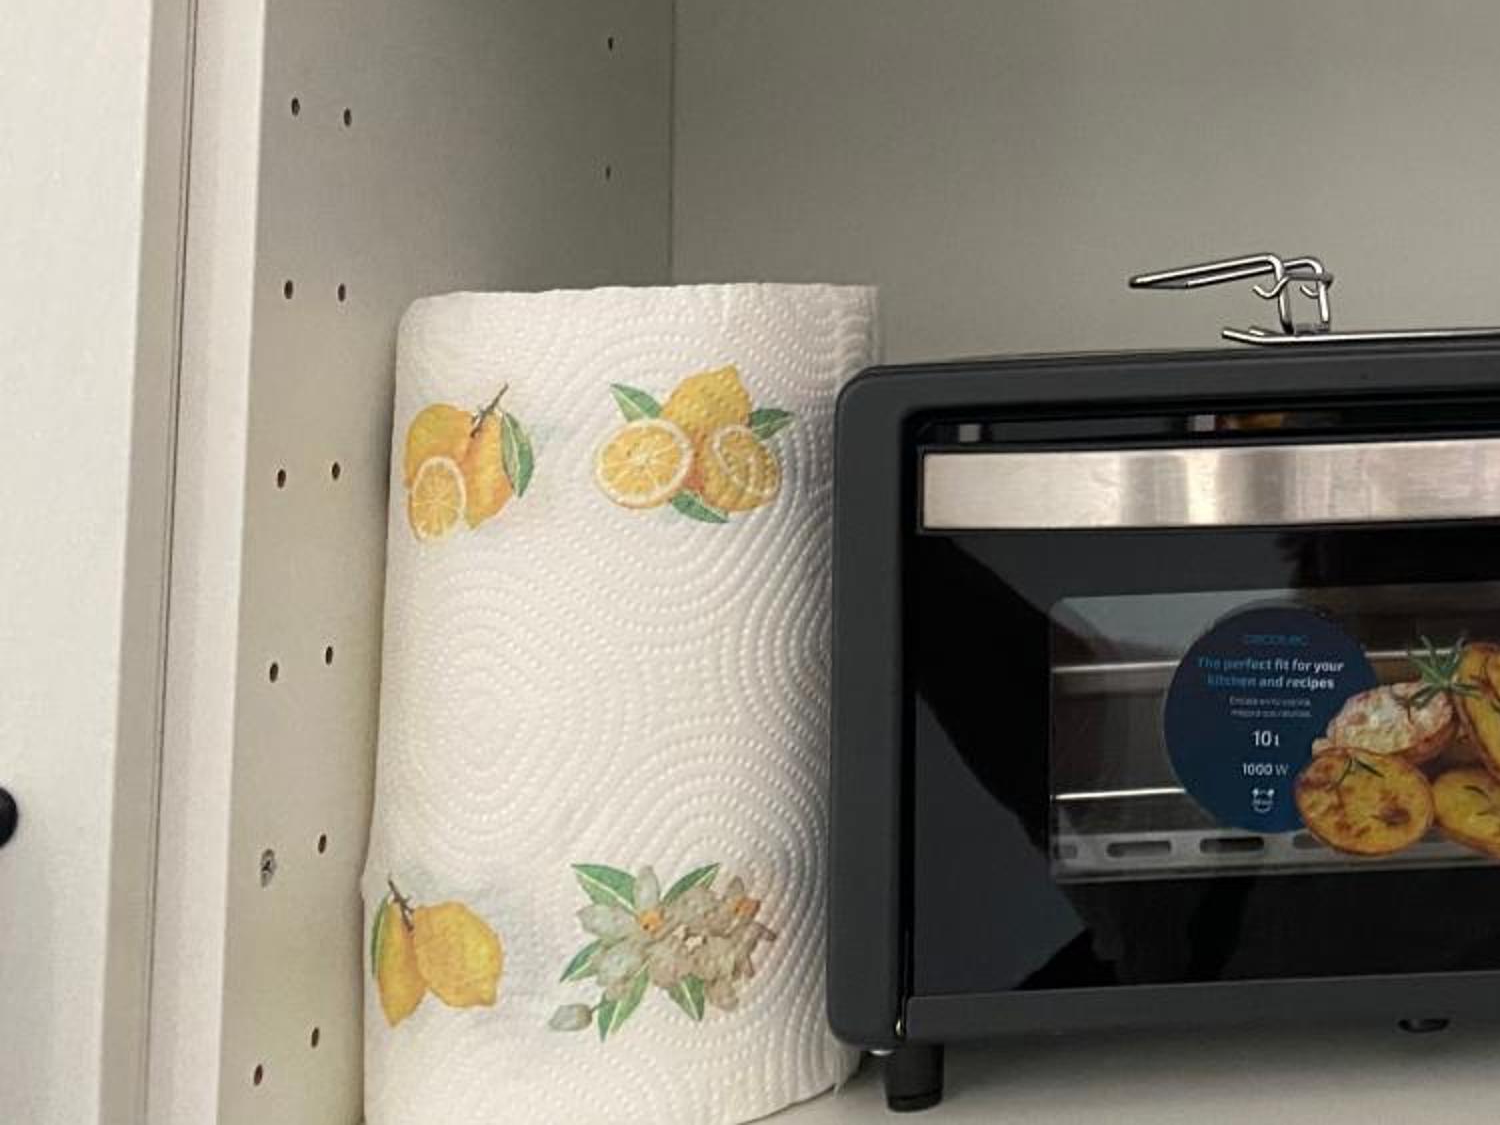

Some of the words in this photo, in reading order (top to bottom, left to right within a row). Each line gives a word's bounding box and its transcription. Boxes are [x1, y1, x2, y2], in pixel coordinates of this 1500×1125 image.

[1199, 657, 1220, 668] The
[1223, 657, 1272, 672] perfect
[1275, 657, 1289, 669] fit
[1292, 658, 1311, 671] for
[1313, 661, 1345, 673] your
[1207, 674, 1257, 687] kitchen
[1259, 676, 1283, 688] and
[1286, 677, 1335, 690] recipes
[1243, 763, 1272, 776] 1000
[1275, 763, 1289, 776] W
